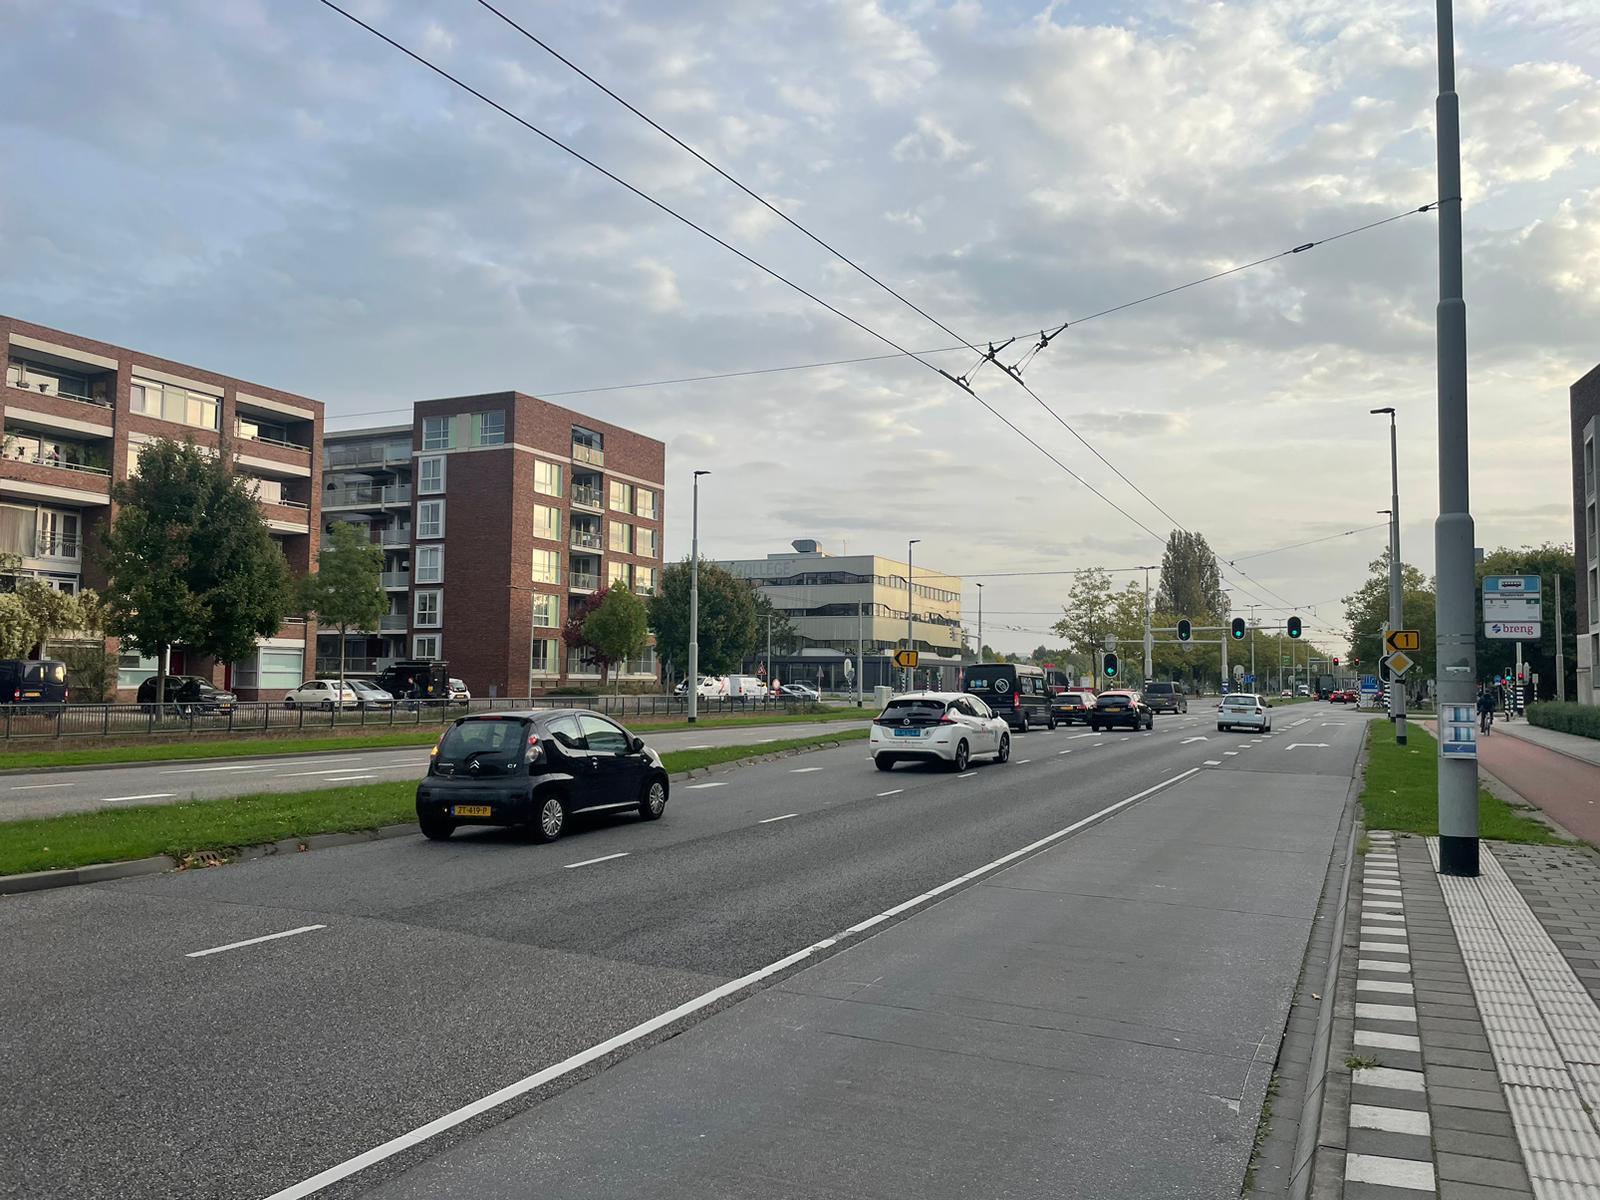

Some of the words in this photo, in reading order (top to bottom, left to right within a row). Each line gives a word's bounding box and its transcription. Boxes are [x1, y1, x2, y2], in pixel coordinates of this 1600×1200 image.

[736, 562, 790, 577] COLLEGE
[1502, 623, 1534, 635] breng
[1404, 634, 1409, 647] 1
